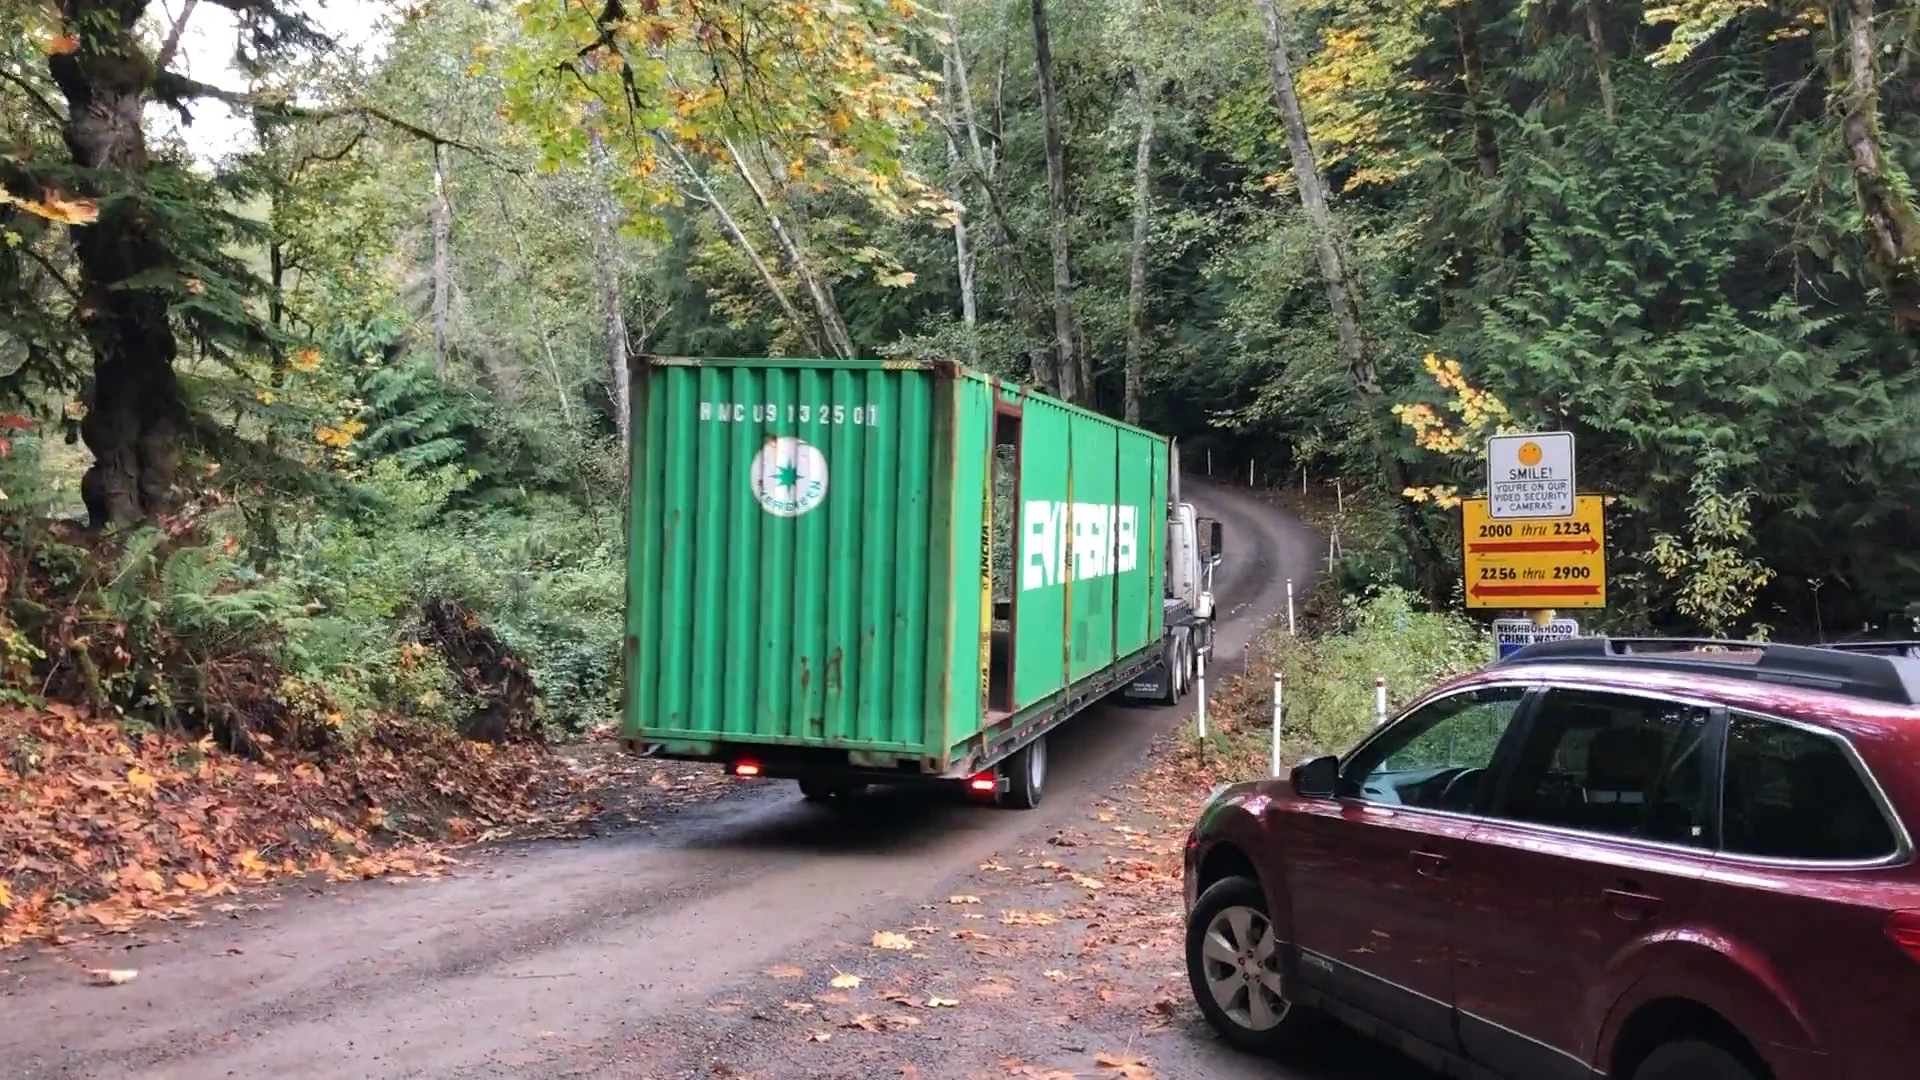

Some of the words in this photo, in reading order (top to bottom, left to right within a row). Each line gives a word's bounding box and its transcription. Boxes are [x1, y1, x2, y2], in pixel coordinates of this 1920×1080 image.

[1509, 467, 1552, 480] SMILE!
[1497, 483, 1528, 492] YOU'RE
[1531, 482, 1544, 492] ON
[1548, 482, 1567, 491] OUR
[1495, 493, 1520, 502] VIDEO
[1524, 491, 1569, 501] SECURITY
[1509, 501, 1553, 511] CAMERAS
[1479, 525, 1513, 537] 2000
[1521, 524, 1547, 536] thru
[1553, 522, 1591, 535] 2234
[1480, 568, 1517, 580] 2256
[1522, 568, 1546, 580] thru
[1552, 567, 1590, 579] 2900
[1499, 634, 1529, 643] CRIME
